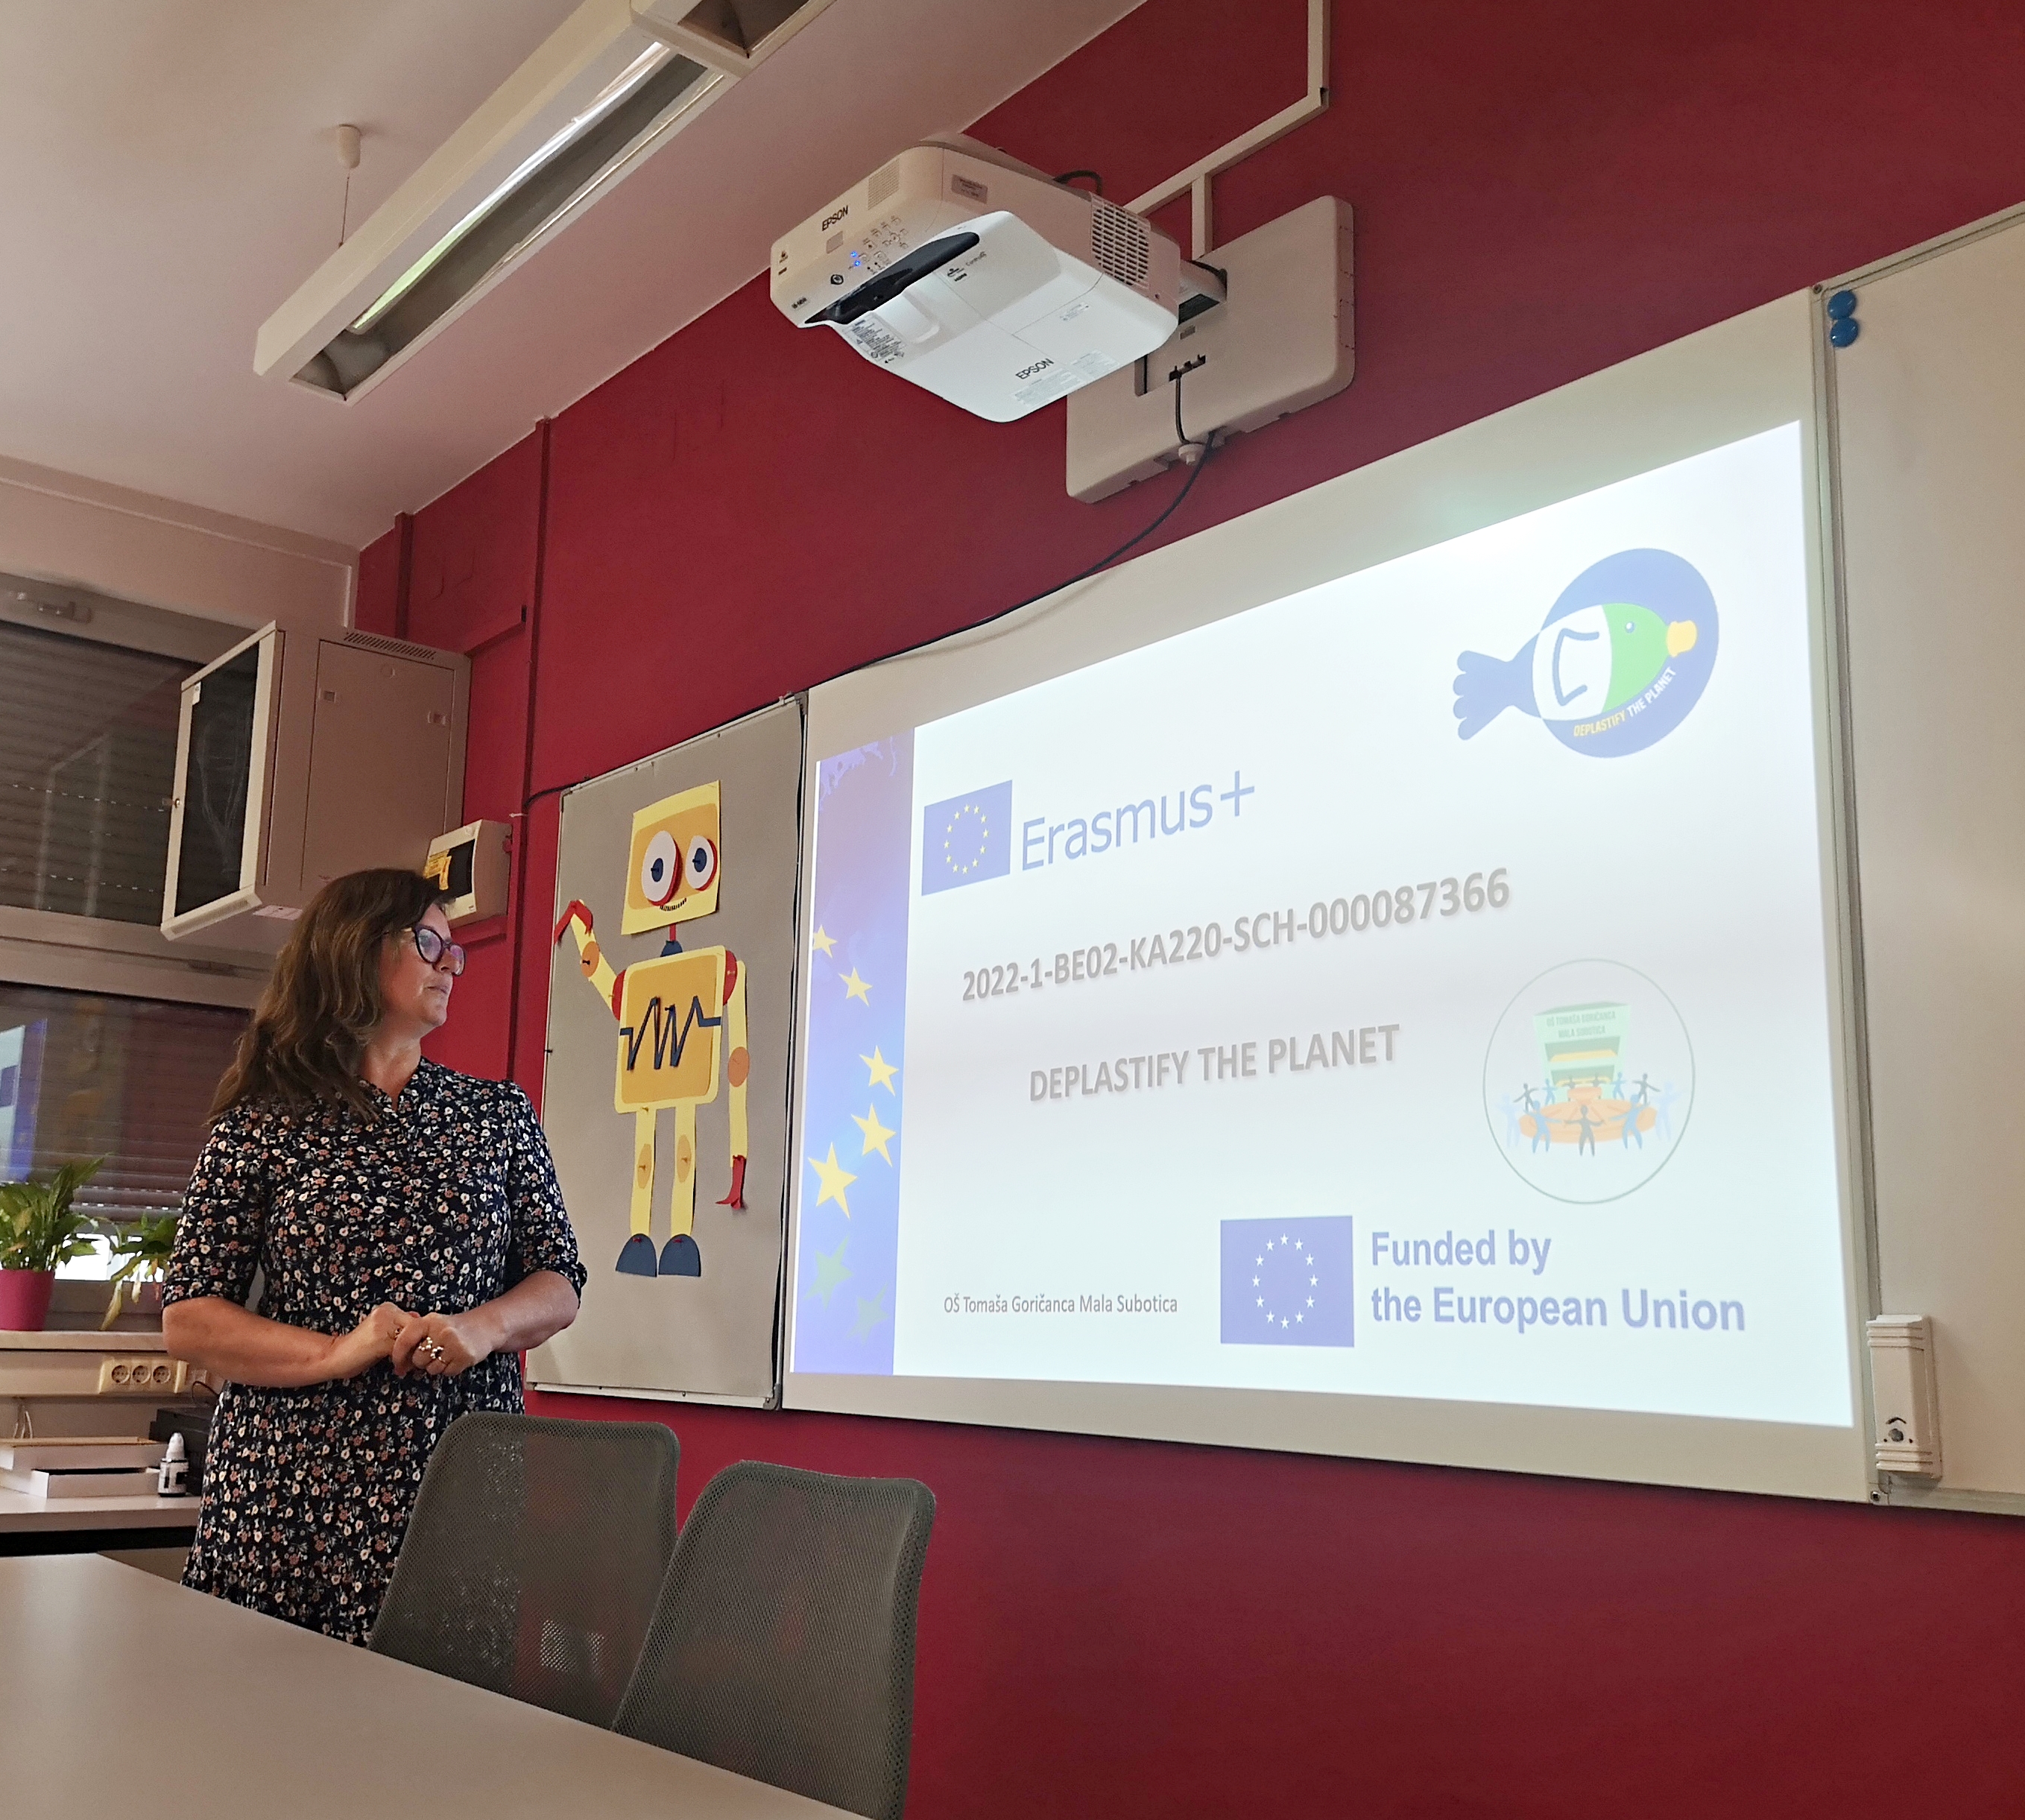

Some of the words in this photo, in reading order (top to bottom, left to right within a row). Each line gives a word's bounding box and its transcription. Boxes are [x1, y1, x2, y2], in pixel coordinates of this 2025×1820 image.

[822, 205, 849, 231] EPSON
[1015, 358, 1055, 379] EPSON
[1573, 710, 1626, 736] DEPLASTIFY
[1626, 698, 1646, 717] THE
[1644, 666, 1676, 704] PLANET
[1023, 770, 1255, 870] Erasmus+
[962, 868, 1511, 1001] 2022-1-BE02-KA220-SCH-000087366
[1030, 1051, 1190, 1102] DEPLASTIFY
[1197, 1041, 1257, 1081] THE
[1269, 1023, 1400, 1074] PLANET
[1371, 1229, 1496, 1266] Funded
[1509, 1229, 1552, 1275] by
[944, 1292, 960, 1313] OŠ
[963, 1294, 1008, 1313] Tomaša
[1011, 1293, 1075, 1313] Goričanca
[1079, 1294, 1113, 1312] Mala
[1116, 1294, 1178, 1313] Subotica
[1371, 1287, 1421, 1322] the
[1433, 1287, 1608, 1334] European
[1622, 1288, 1746, 1331] Union
